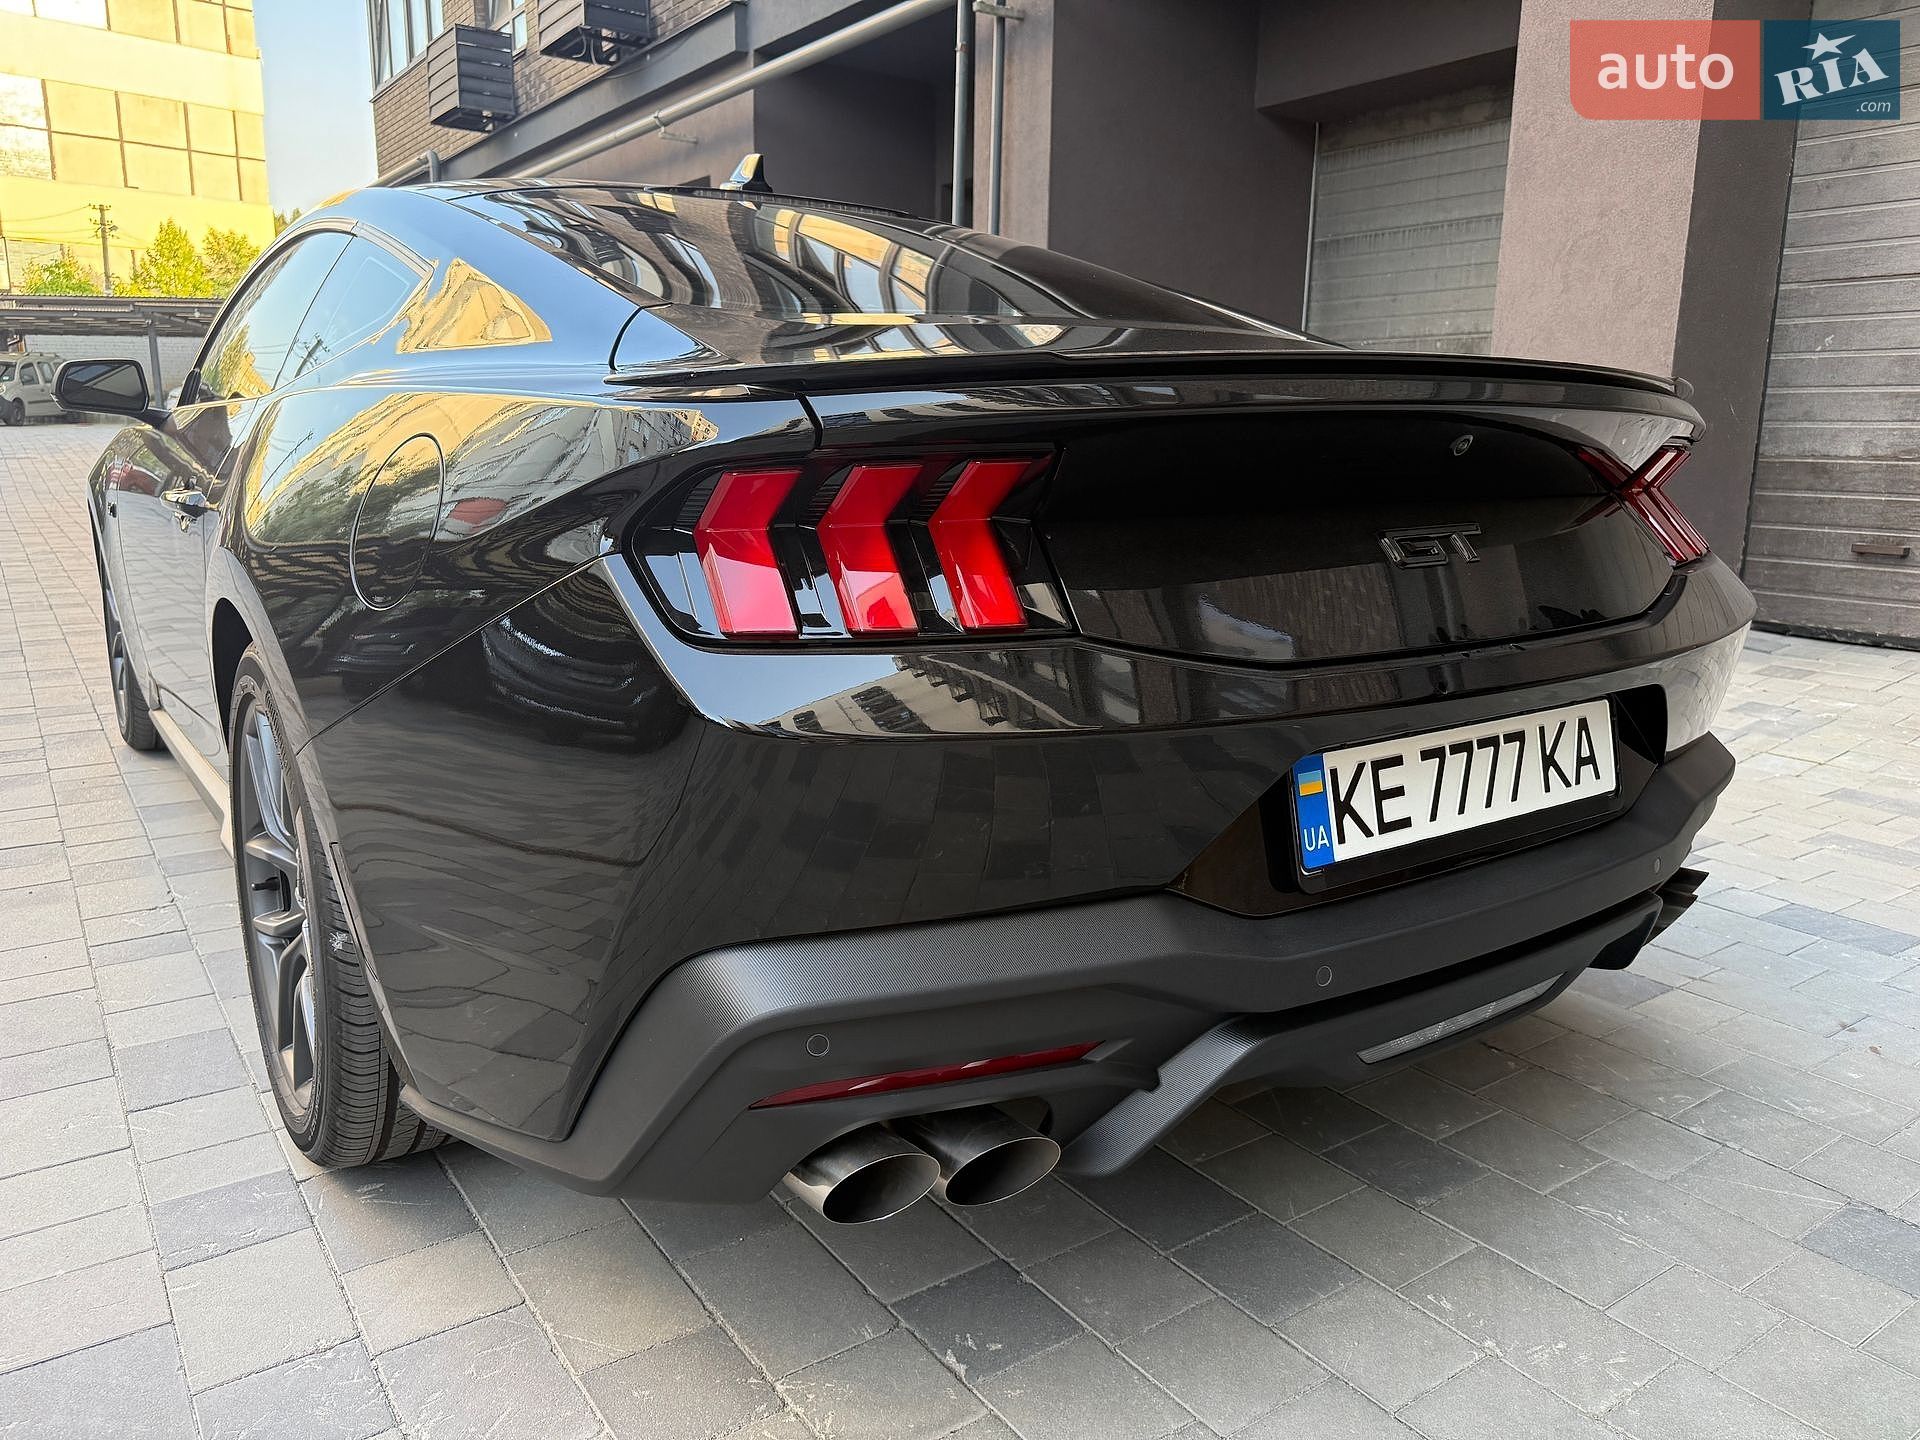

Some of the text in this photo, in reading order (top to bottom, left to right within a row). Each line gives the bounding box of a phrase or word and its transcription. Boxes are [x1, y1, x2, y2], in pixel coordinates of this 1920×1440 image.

[1376, 522, 1481, 569] GT
[1329, 716, 1600, 845] KE 7777 KA
[1303, 825, 1329, 851] UA
